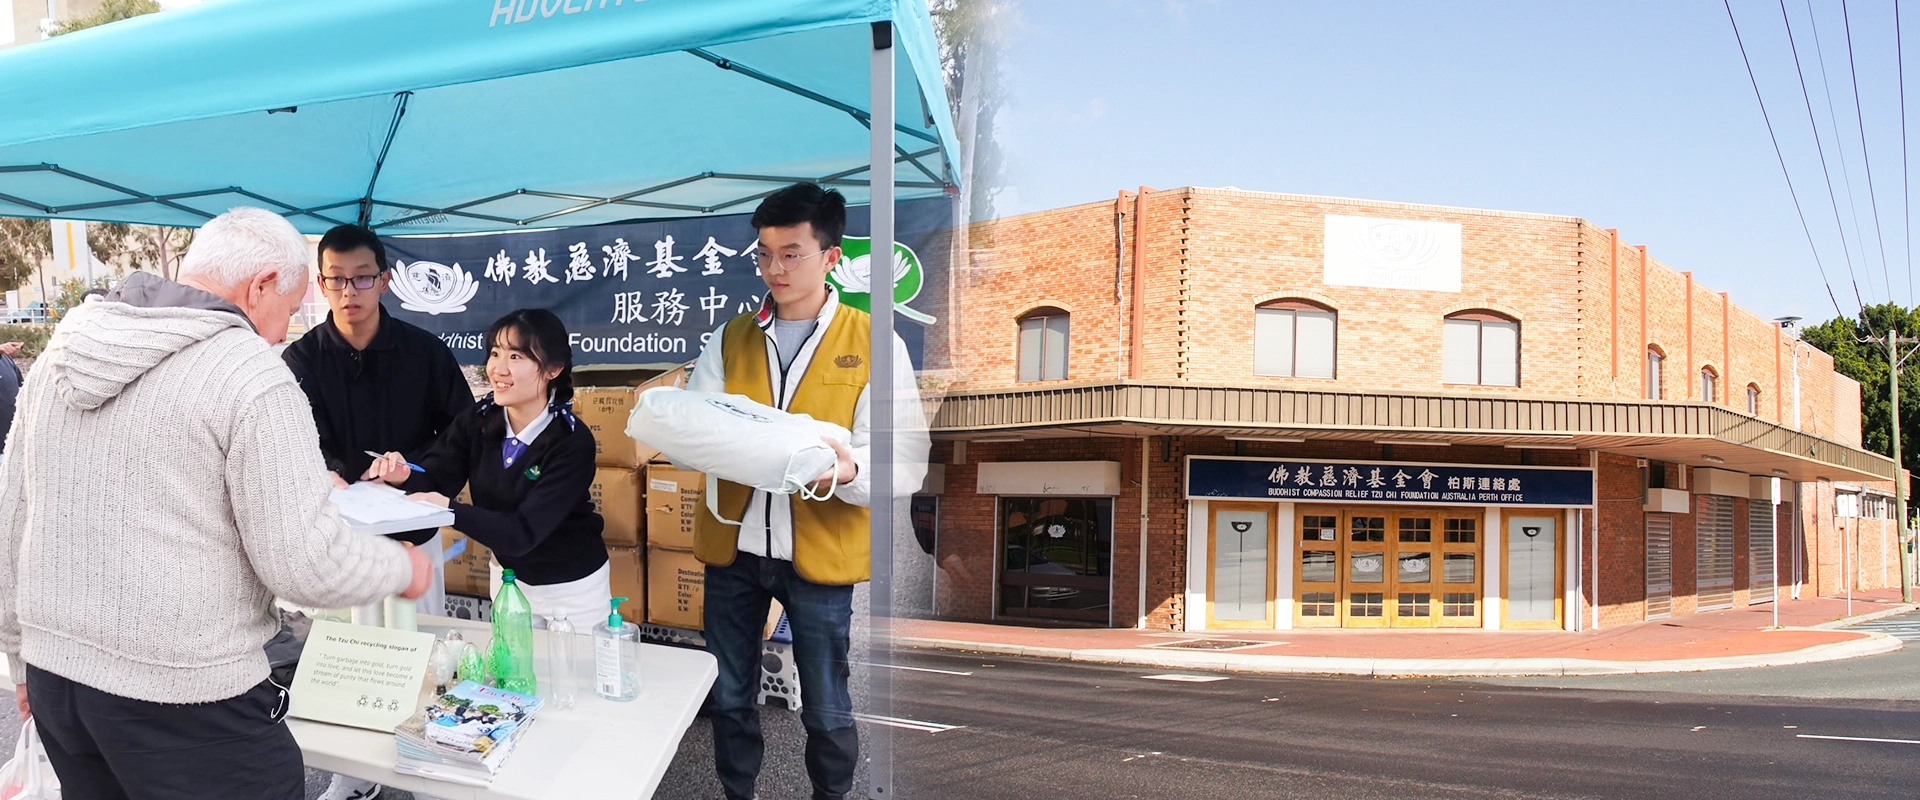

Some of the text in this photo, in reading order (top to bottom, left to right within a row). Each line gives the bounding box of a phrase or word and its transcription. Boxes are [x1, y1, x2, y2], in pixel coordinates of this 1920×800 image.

[568, 332, 687, 354] Foundation
[1267, 464, 1522, 492] 佛教慈濟基金會 柏斯連絡處
[1268, 487, 1300, 497] BUDDHIST
[1303, 489, 1343, 498] COMPASSION
[1345, 490, 1369, 498] RELIEF
[1371, 491, 1383, 499] TZU
[1385, 491, 1397, 499] CHI
[1400, 491, 1439, 500] FOUNDATION
[1441, 492, 1477, 501] AUSTRALIA
[1501, 494, 1524, 502] OFFICE
[360, 640, 388, 650] recycling
[389, 644, 409, 652] slogan
[327, 662, 340, 671] love,
[361, 667, 373, 675] this
[386, 671, 408, 679] become
[336, 656, 359, 665] garbage
[371, 661, 385, 669] gold,
[333, 670, 340, 678] of
[340, 673, 357, 681] purity
[357, 675, 370, 683] that
[385, 680, 406, 688] around
